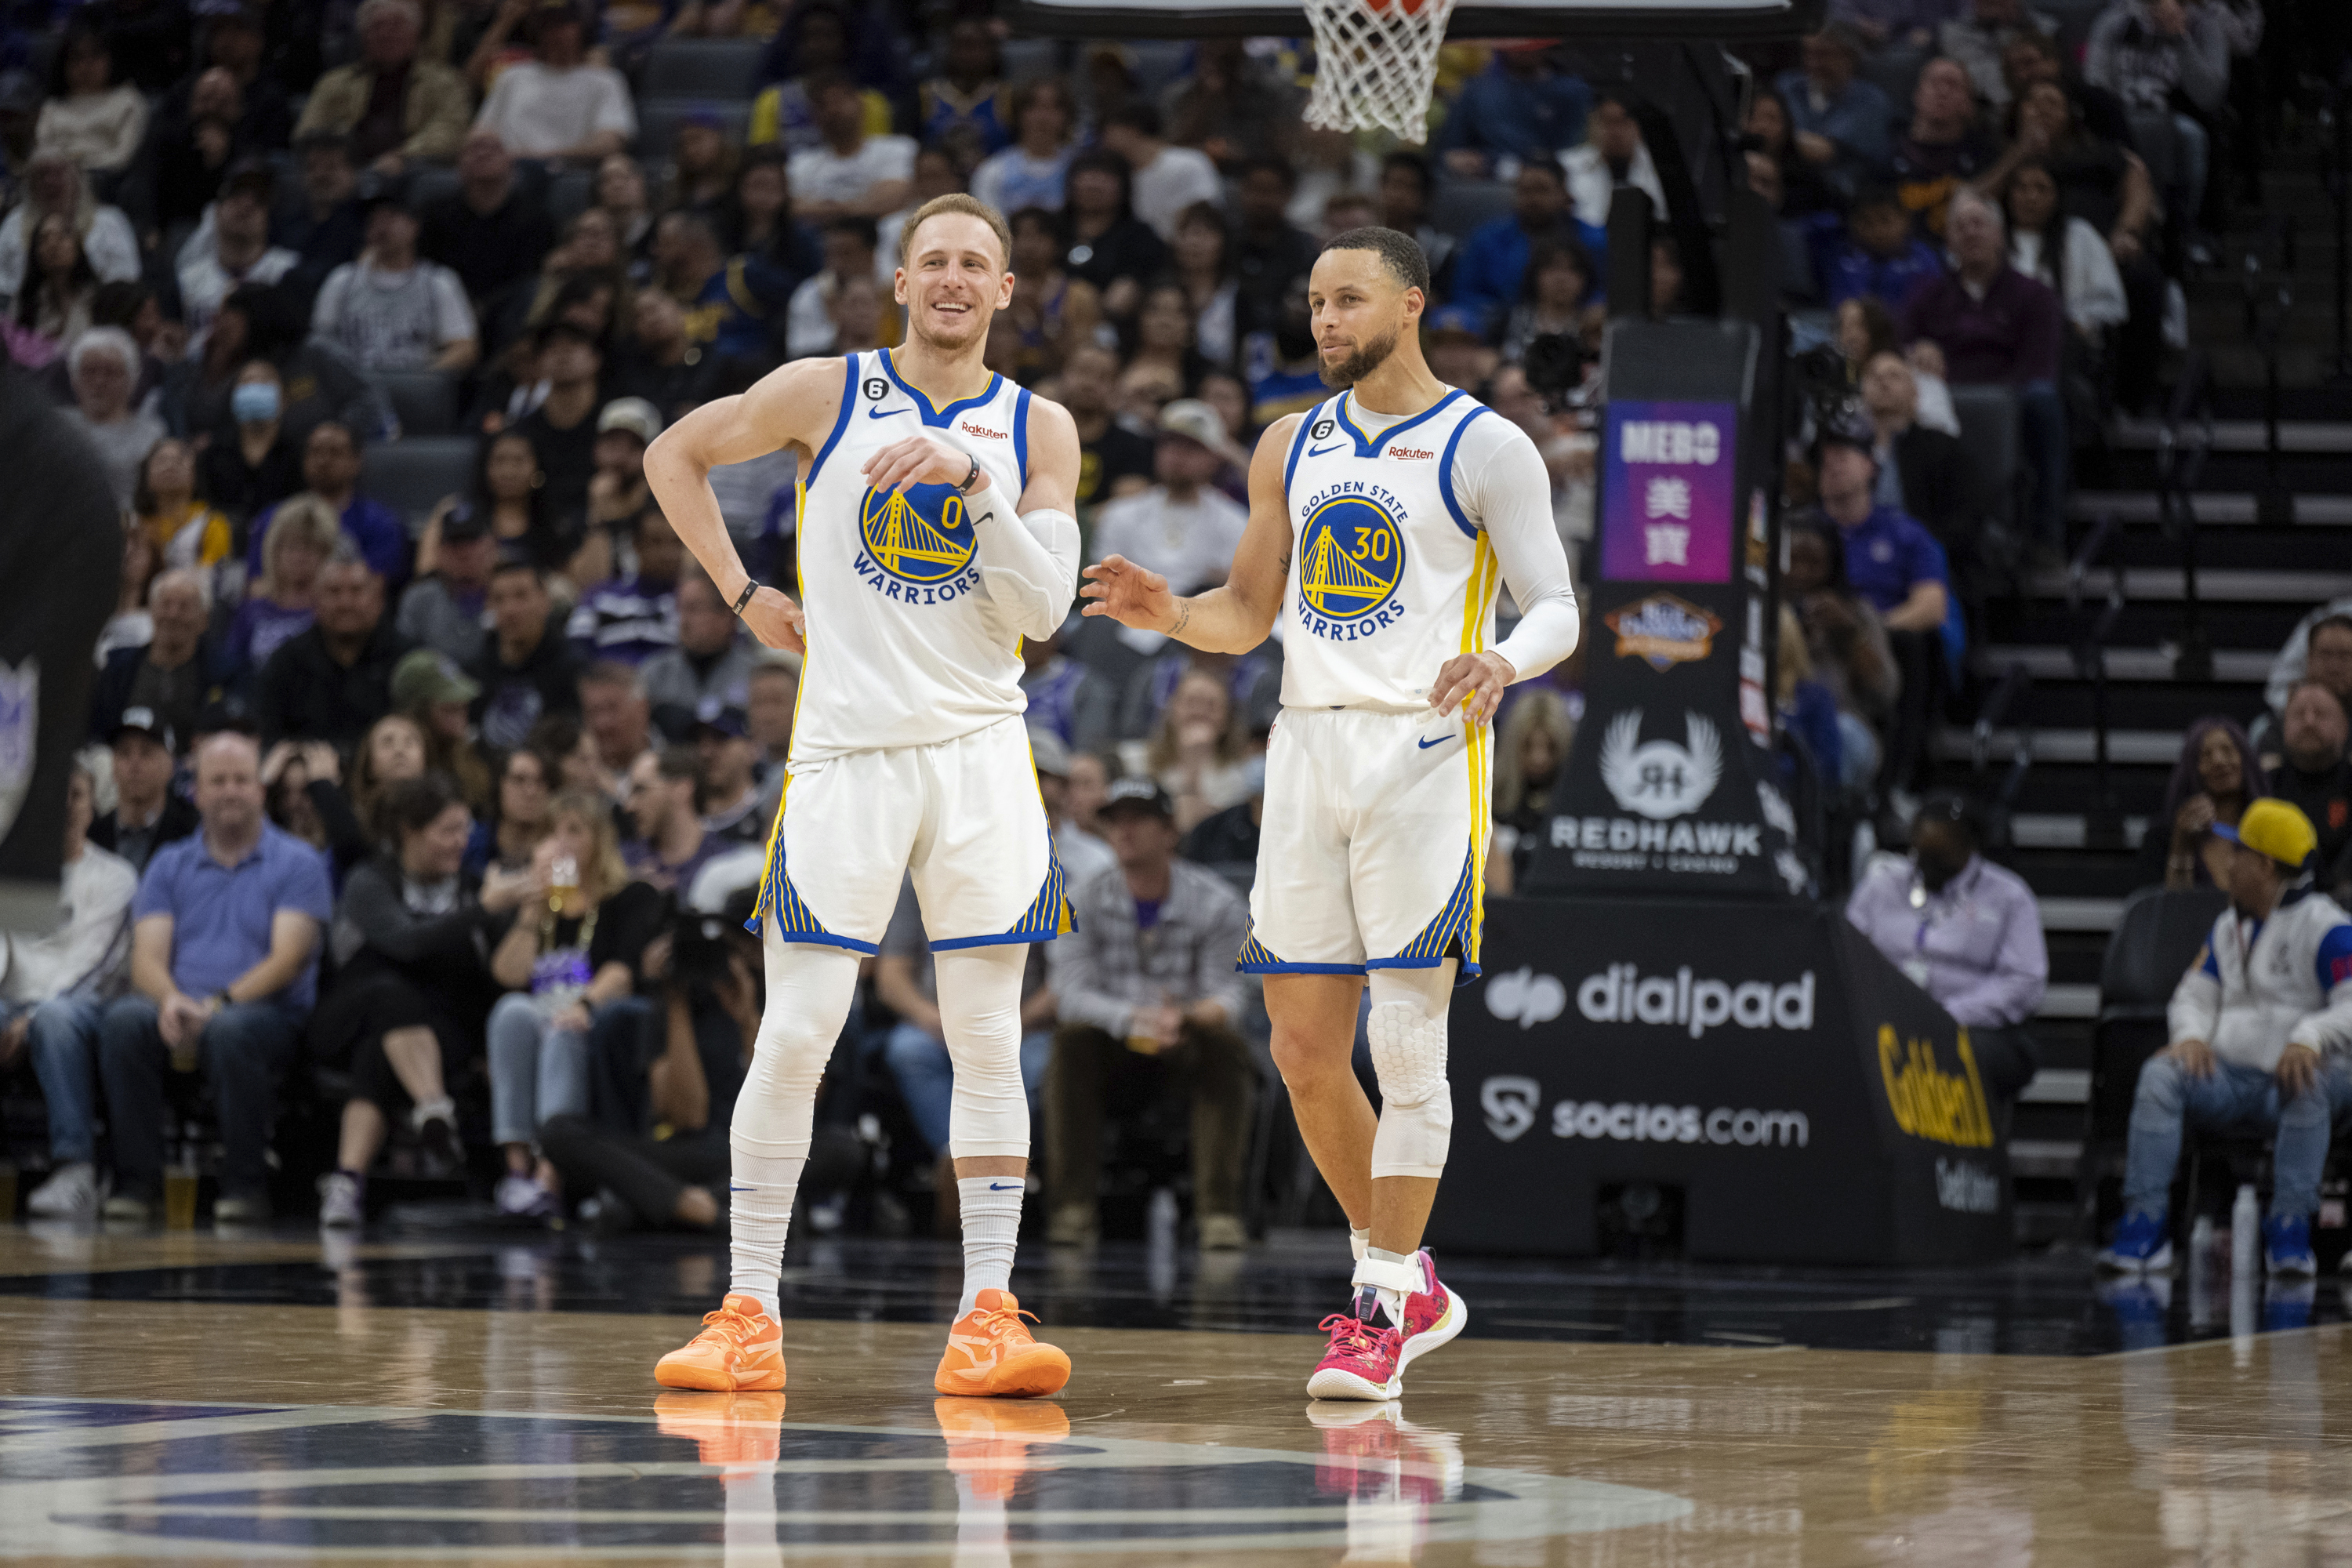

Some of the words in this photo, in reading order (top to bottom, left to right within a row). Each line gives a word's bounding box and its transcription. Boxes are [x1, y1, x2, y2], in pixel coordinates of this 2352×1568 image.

[868, 380, 884, 398] 6
[961, 421, 1008, 440] Rakuten
[1315, 422, 1332, 438] 6
[1388, 446, 1434, 460] Rakuten
[941, 495, 964, 529] 0
[1301, 481, 1364, 517] GOLDEN
[1370, 485, 1409, 524] STATE
[1351, 526, 1391, 561] 30
[852, 550, 981, 605] WARRIORS
[1298, 591, 1405, 641] WARRIORS
[1551, 815, 1762, 856] REDHAWK
[1576, 962, 1816, 1039] dialpad
[1552, 1100, 1809, 1148] socios.com
